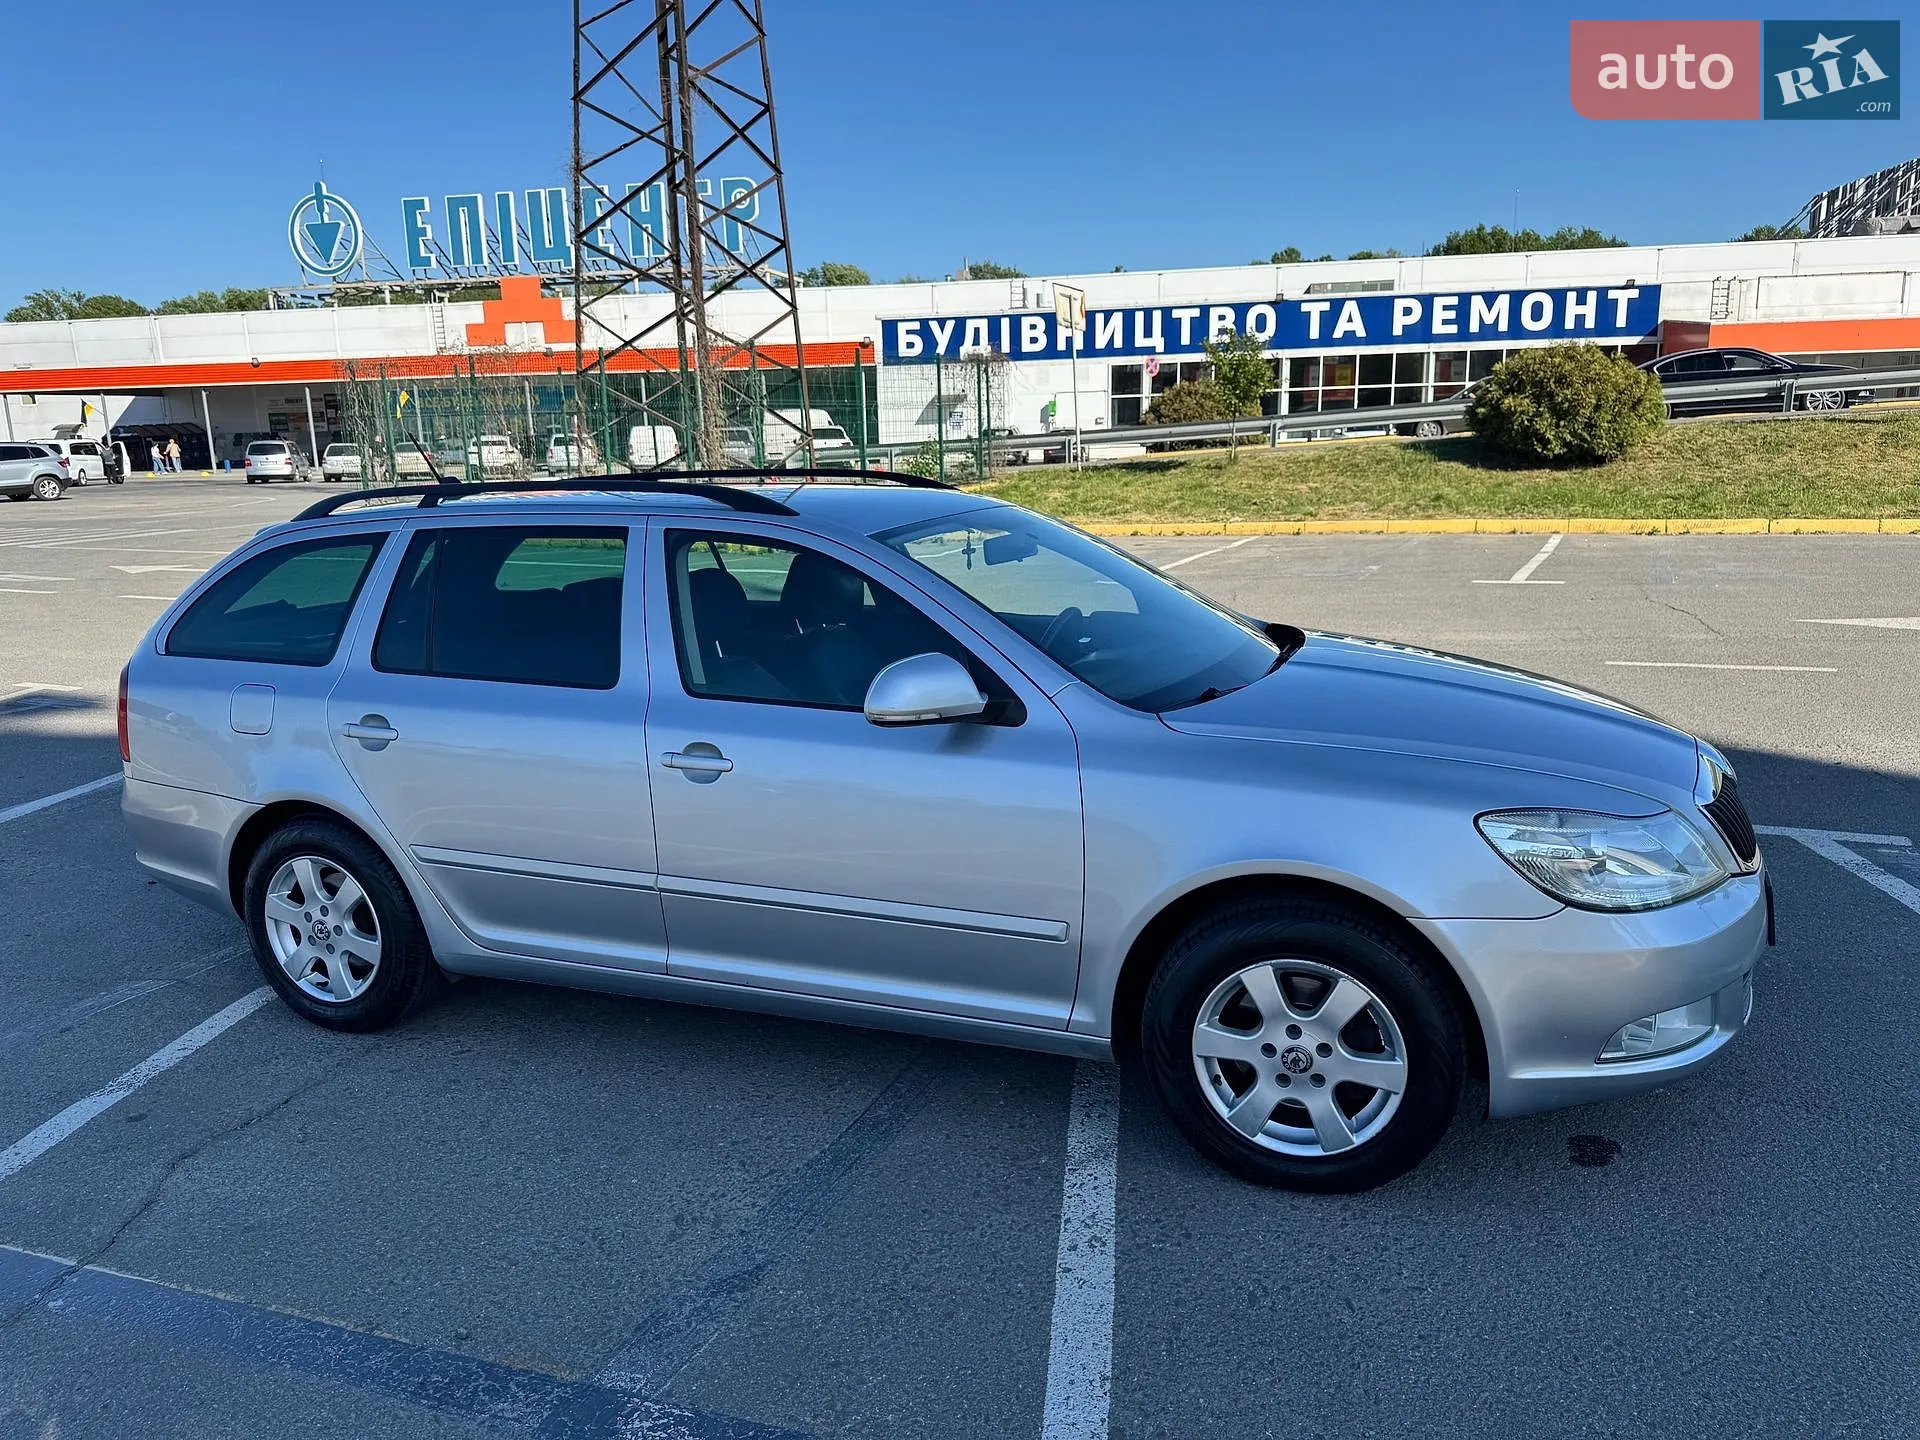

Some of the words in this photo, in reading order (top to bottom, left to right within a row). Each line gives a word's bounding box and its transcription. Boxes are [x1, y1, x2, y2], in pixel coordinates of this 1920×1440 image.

[896, 303, 1278, 359] БУДІВНИЦТВО
[1300, 300, 1367, 340] ТА
[1391, 288, 1640, 337] РЕМОНТ
